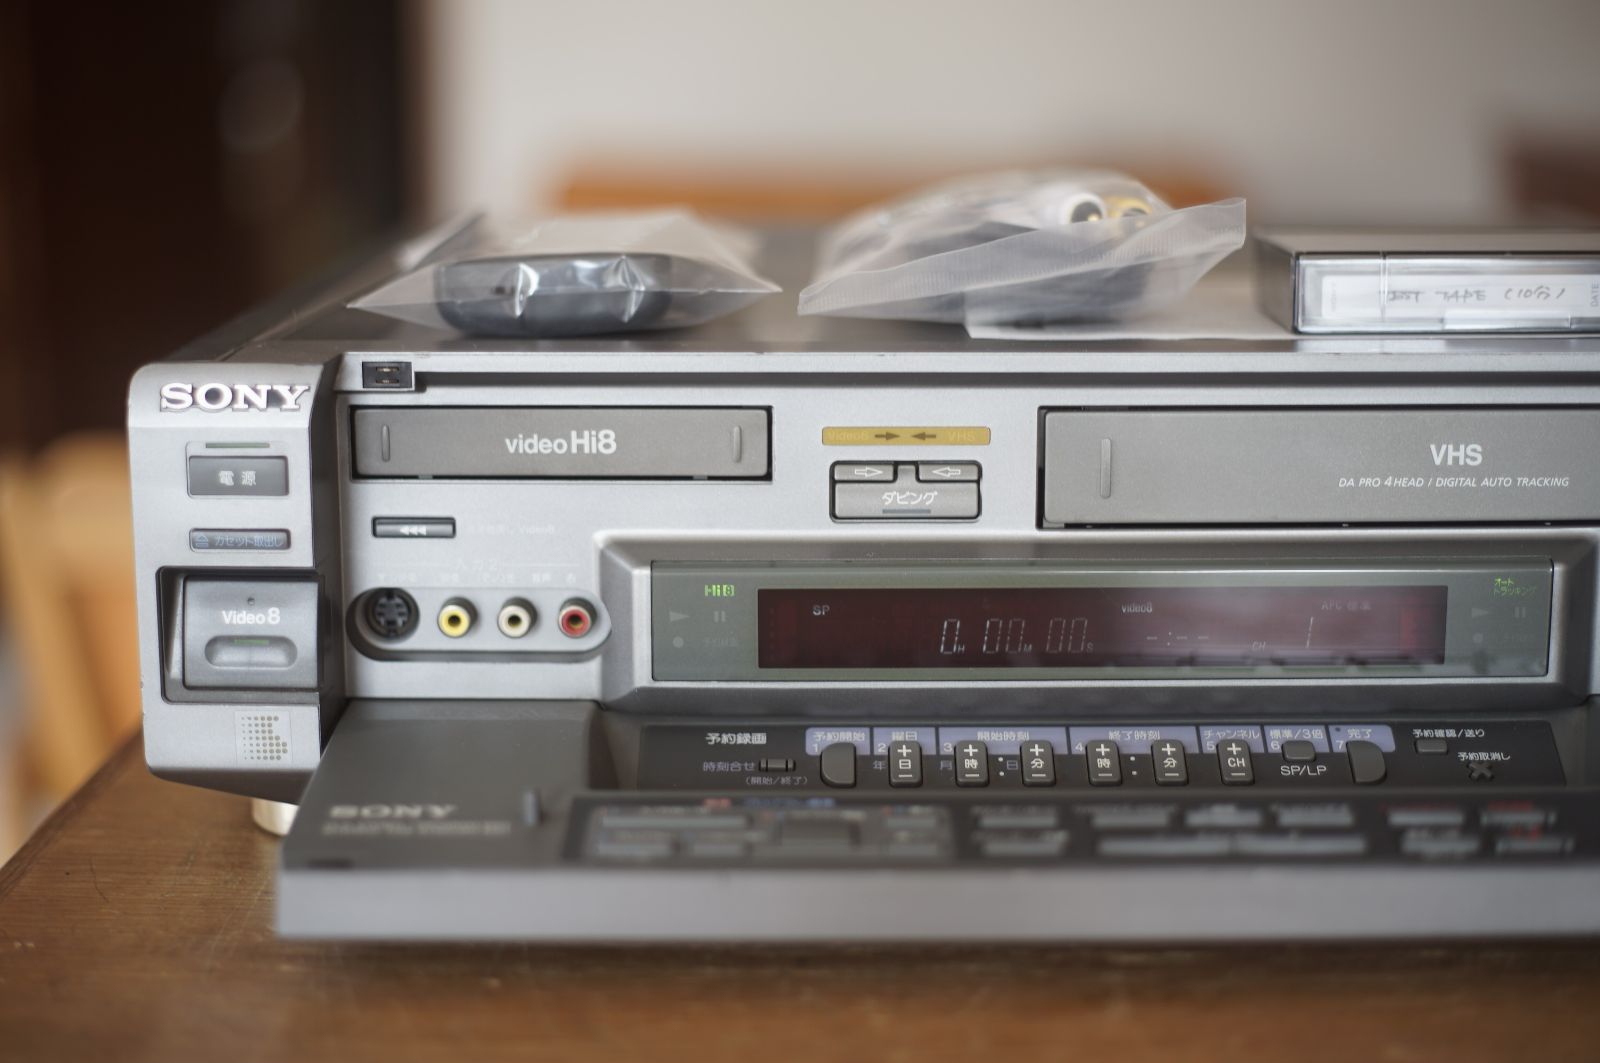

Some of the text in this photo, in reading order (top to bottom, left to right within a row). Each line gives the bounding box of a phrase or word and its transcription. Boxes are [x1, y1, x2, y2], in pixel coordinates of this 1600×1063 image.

[160, 382, 310, 412] SONY
[948, 431, 976, 442] VHS
[1429, 443, 1483, 466] VHS
[1338, 477, 1355, 488] DA
[1358, 477, 1381, 488] PRO
[1435, 476, 1477, 488] DIGITAL
[1480, 476, 1512, 488] AUTO
[1516, 476, 1570, 488] TRACKING
[882, 490, 938, 506] ダビング
[812, 604, 831, 616] SP
[705, 732, 768, 745] 予約録画
[976, 730, 1031, 742] 開始時刻
[1108, 729, 1161, 741] 終了時刻
[1202, 729, 1261, 741] チャンネル
[1347, 728, 1373, 740] 完了
[877, 742, 887, 753] 2
[943, 742, 953, 753] 3
[1074, 742, 1084, 752] 4
[1206, 741, 1216, 751] 5
[1270, 740, 1281, 751] 6
[1335, 740, 1345, 750] 7
[964, 758, 979, 769] 時
[1030, 758, 1045, 769] 分
[1096, 758, 1111, 769] 時
[1163, 758, 1178, 769] 分
[1226, 757, 1246, 768] CH
[1280, 765, 1328, 777] SP/LP
